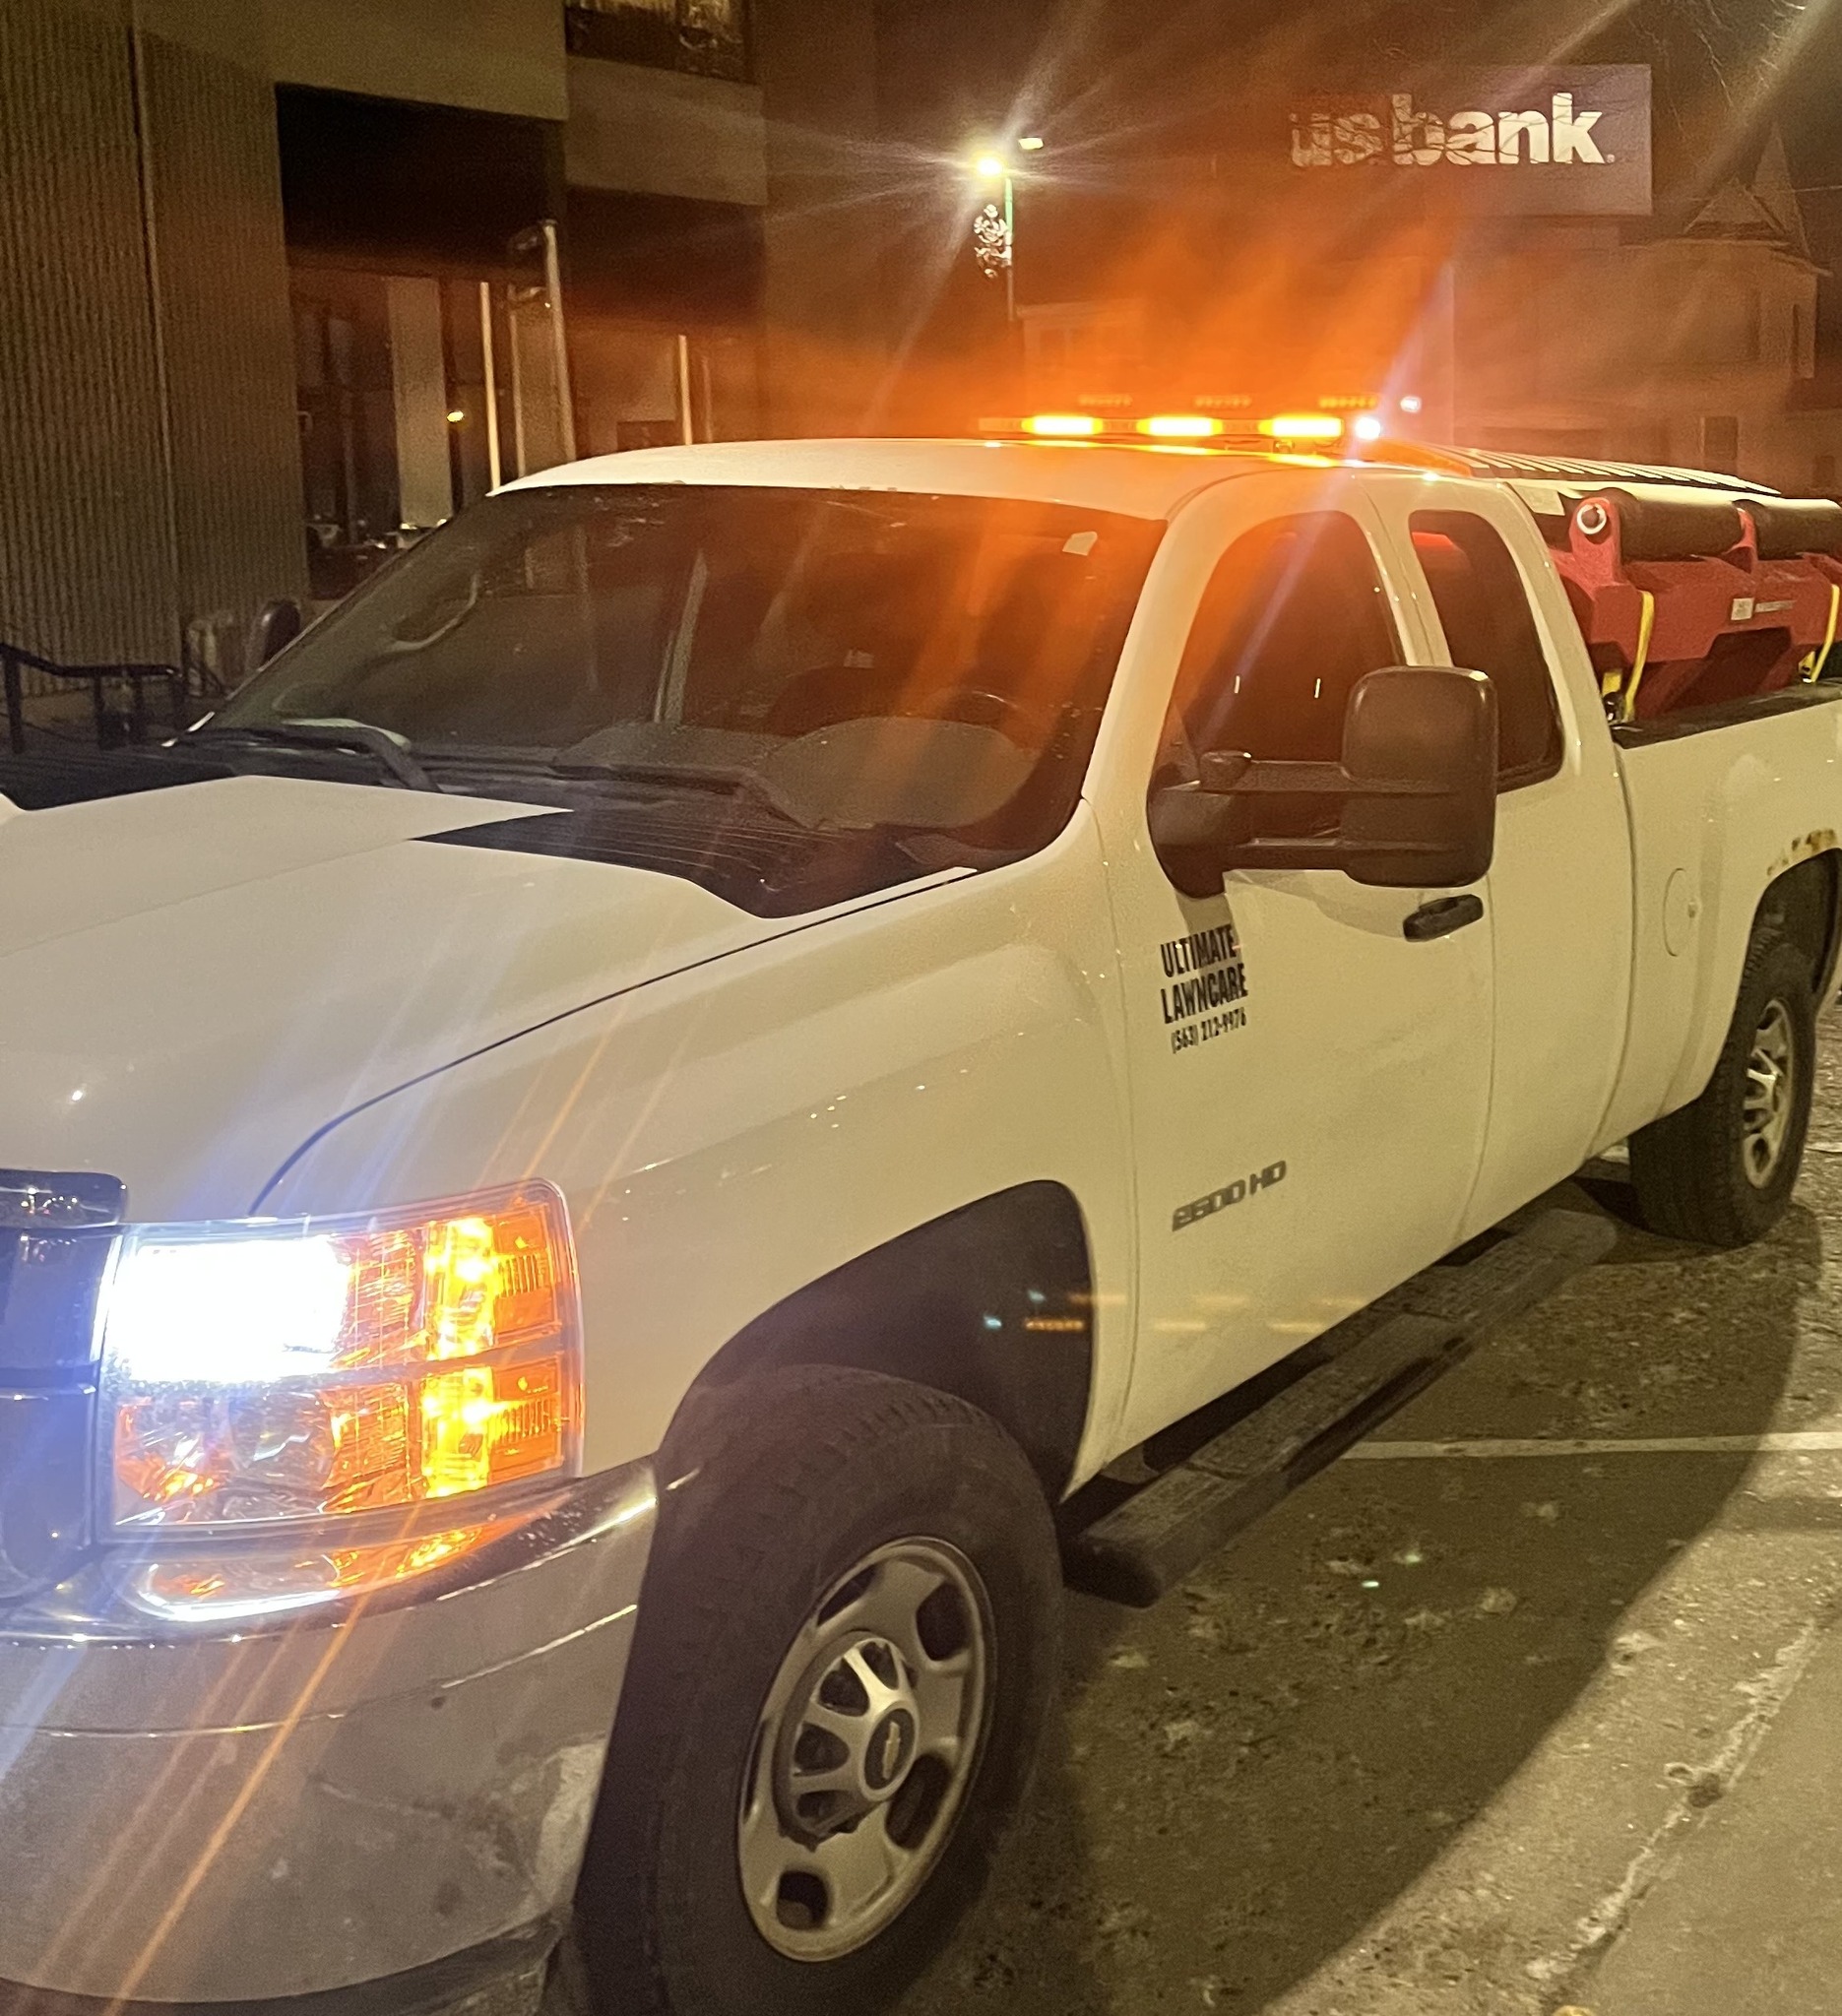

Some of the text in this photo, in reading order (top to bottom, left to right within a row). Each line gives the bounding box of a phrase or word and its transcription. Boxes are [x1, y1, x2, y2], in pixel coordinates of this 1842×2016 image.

[1161, 923, 1237, 977] ULTIMATE
[1161, 963, 1248, 1024] LAWNCARE
[1172, 1160, 1287, 1232] 2500 HD
